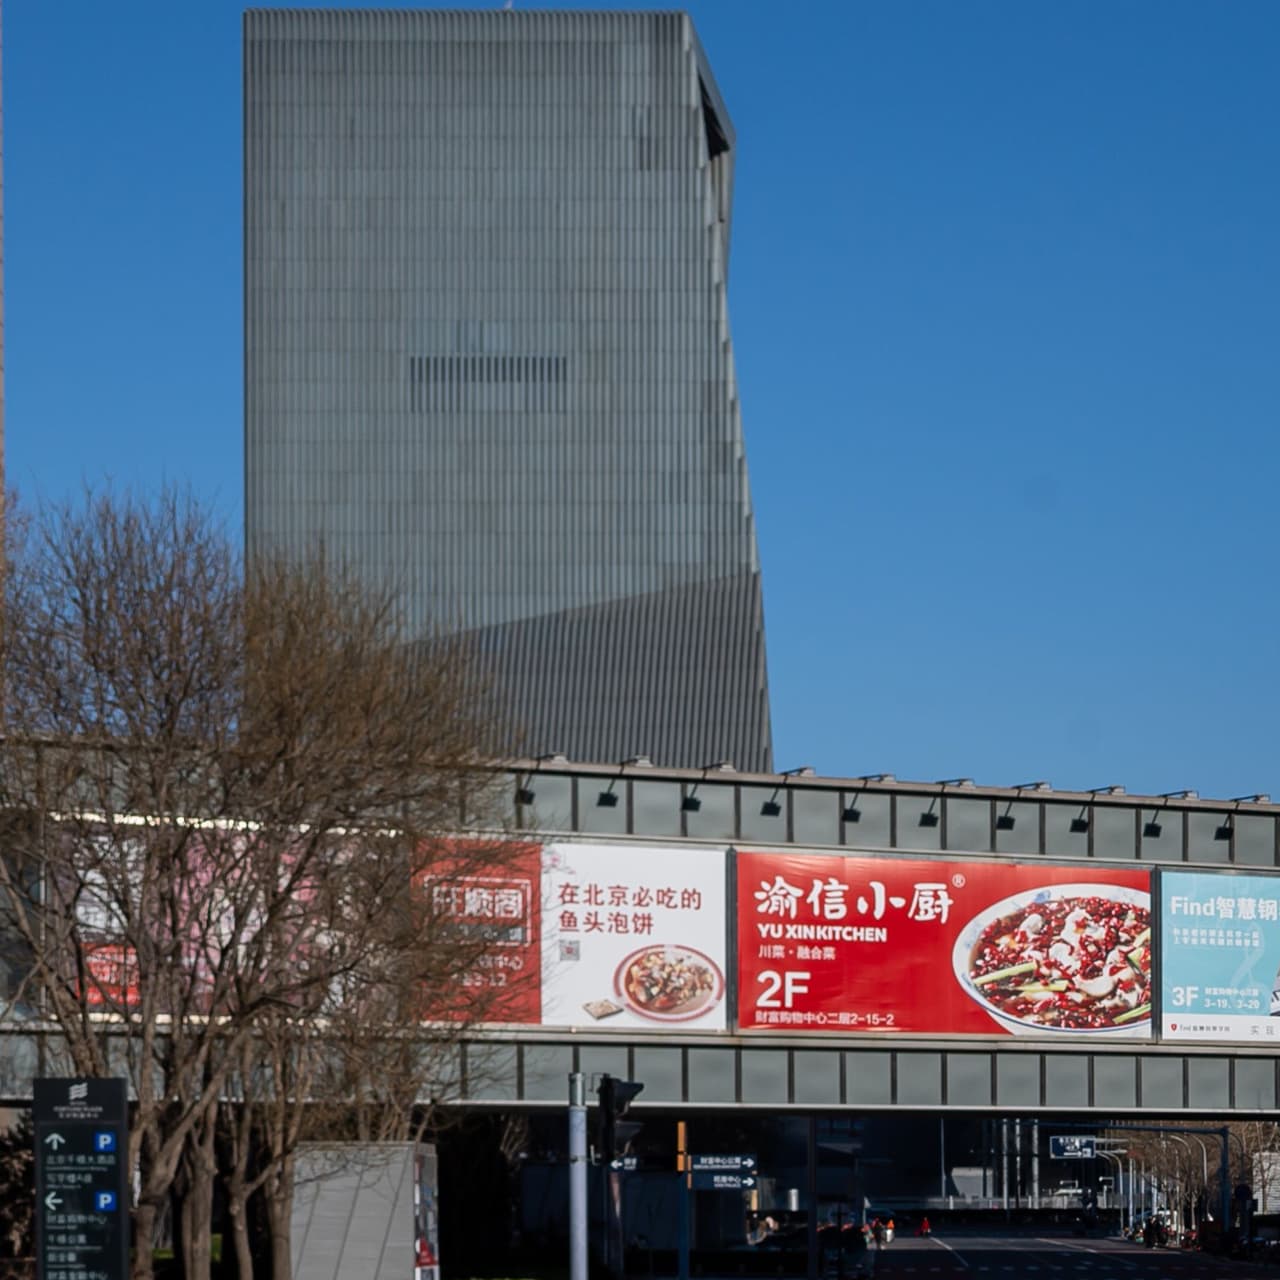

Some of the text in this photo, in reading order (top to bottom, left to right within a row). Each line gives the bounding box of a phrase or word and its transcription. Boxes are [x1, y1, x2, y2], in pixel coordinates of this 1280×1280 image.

[558, 883, 702, 910] 在北京必吃的
[754, 876, 954, 924] 渝信小厨
[558, 912, 654, 935] 鱼头泡饼
[756, 970, 811, 1008] 2F
[1172, 986, 1199, 1007] 3F
[99, 1134, 112, 1149] P
[99, 1194, 112, 1208] P
